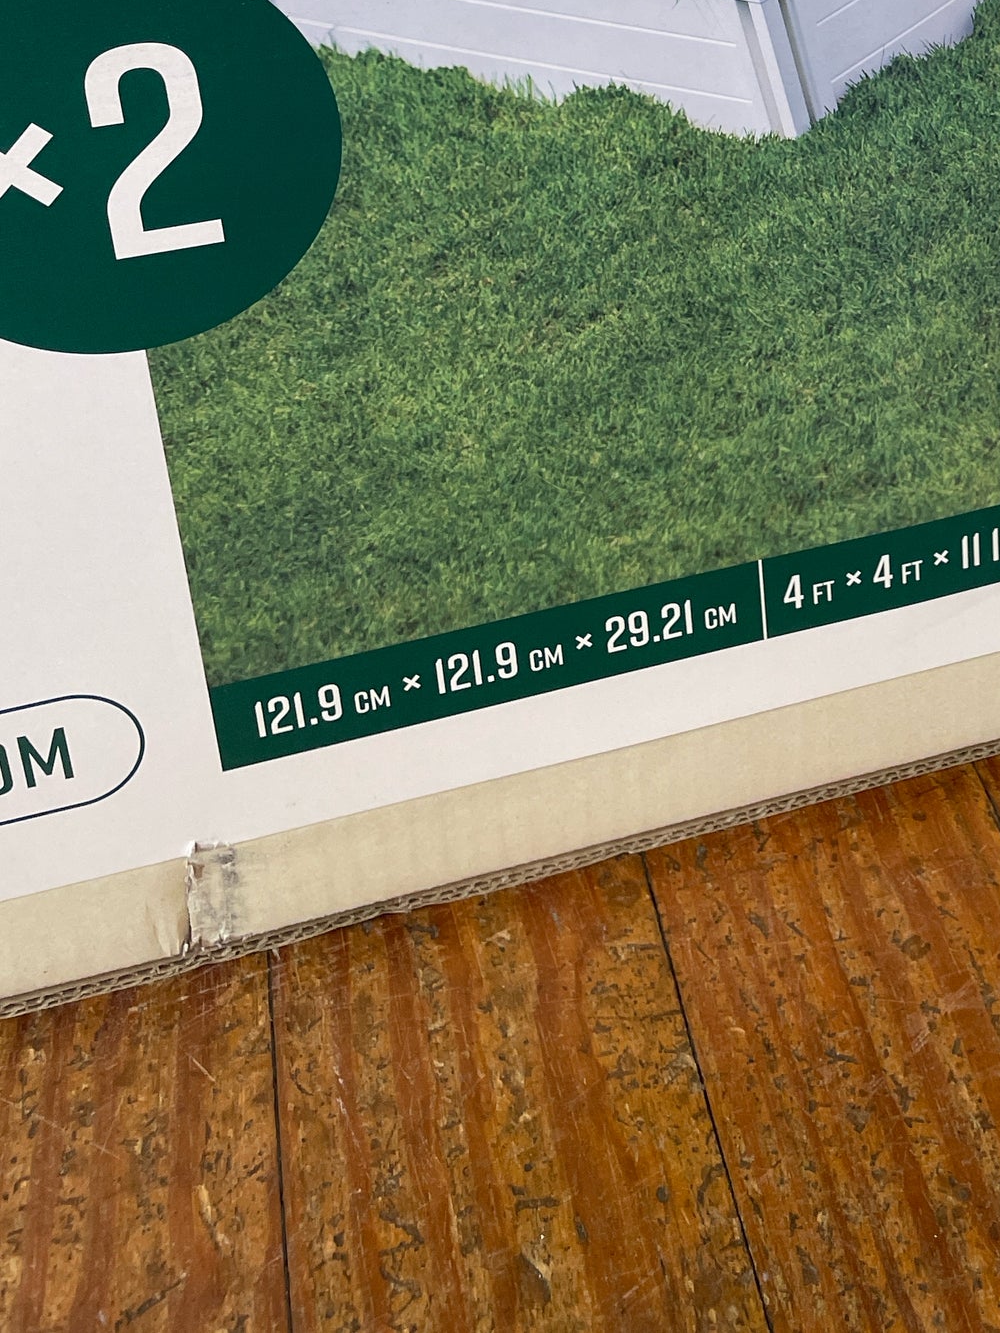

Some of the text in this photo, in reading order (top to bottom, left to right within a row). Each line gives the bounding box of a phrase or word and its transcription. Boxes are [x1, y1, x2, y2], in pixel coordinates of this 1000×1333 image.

[255, 684, 342, 737] 121.9
[436, 642, 517, 694] 121.9
[606, 600, 693, 653] 29.21
[784, 575, 804, 608] 4
[873, 555, 893, 588] 4
[962, 533, 980, 569] 11
